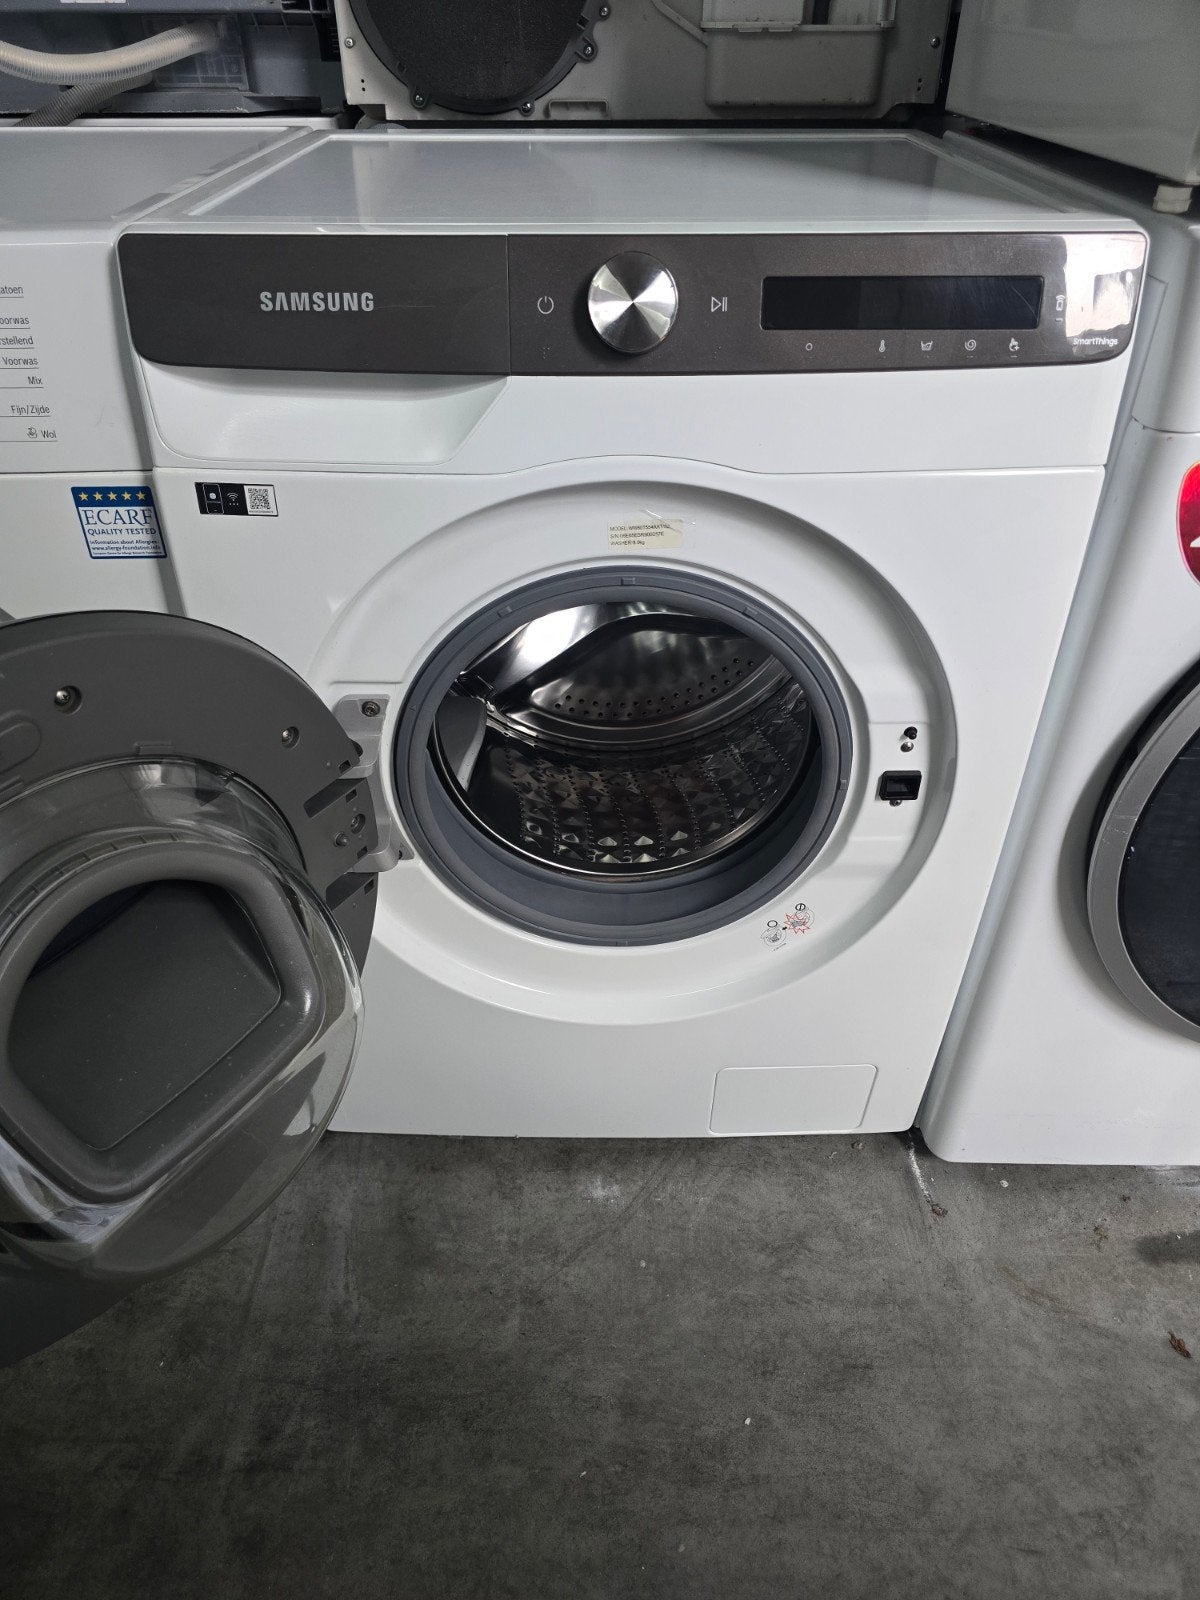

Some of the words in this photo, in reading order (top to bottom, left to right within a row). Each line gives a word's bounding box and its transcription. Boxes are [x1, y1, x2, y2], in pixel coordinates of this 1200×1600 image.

[260, 291, 375, 312] SAMSUNG
[1073, 337, 1119, 347] SmartThings
[2, 357, 39, 366] Voorwas
[27, 376, 43, 385] Mix
[11, 405, 50, 415] Fijn/Zijde
[41, 430, 57, 438] Wol
[82, 509, 152, 526] ECARF
[87, 528, 123, 536] QUALITY
